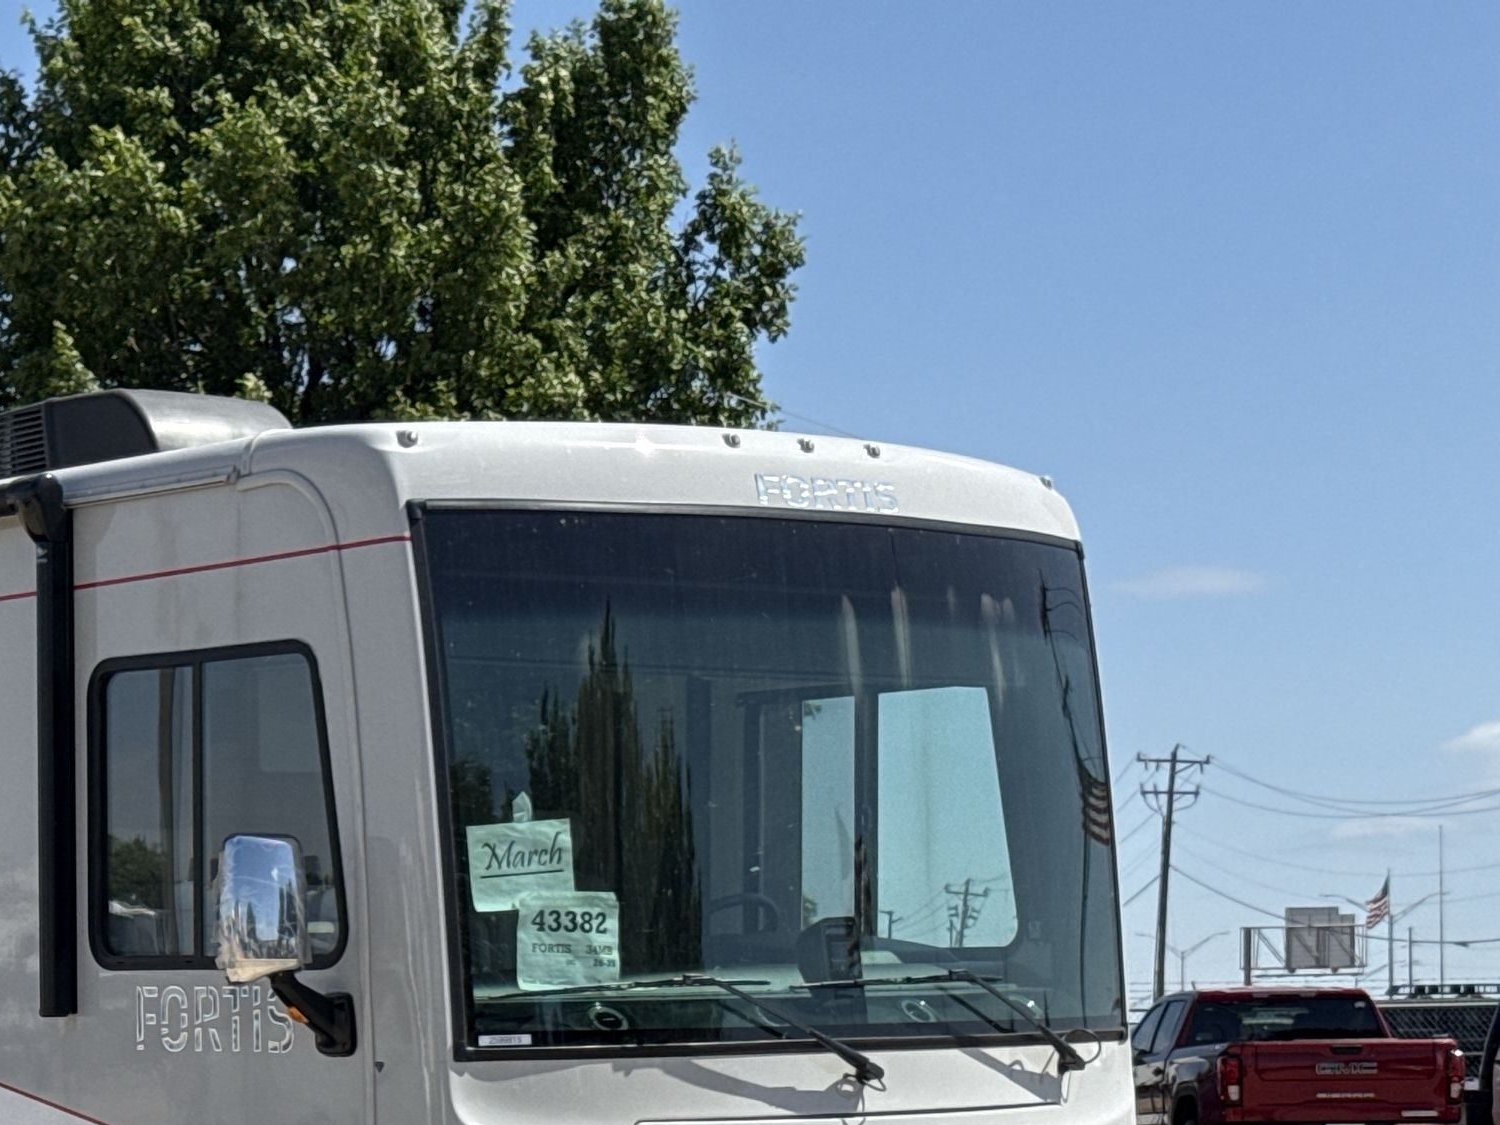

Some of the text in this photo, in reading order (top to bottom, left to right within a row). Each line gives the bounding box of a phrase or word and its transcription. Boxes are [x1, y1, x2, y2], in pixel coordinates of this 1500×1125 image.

[754, 473, 900, 514] FORTIS
[481, 831, 564, 872] March
[530, 909, 608, 935] 43382
[531, 942, 572, 954] FORTIS
[136, 985, 294, 1053] FORTIS
